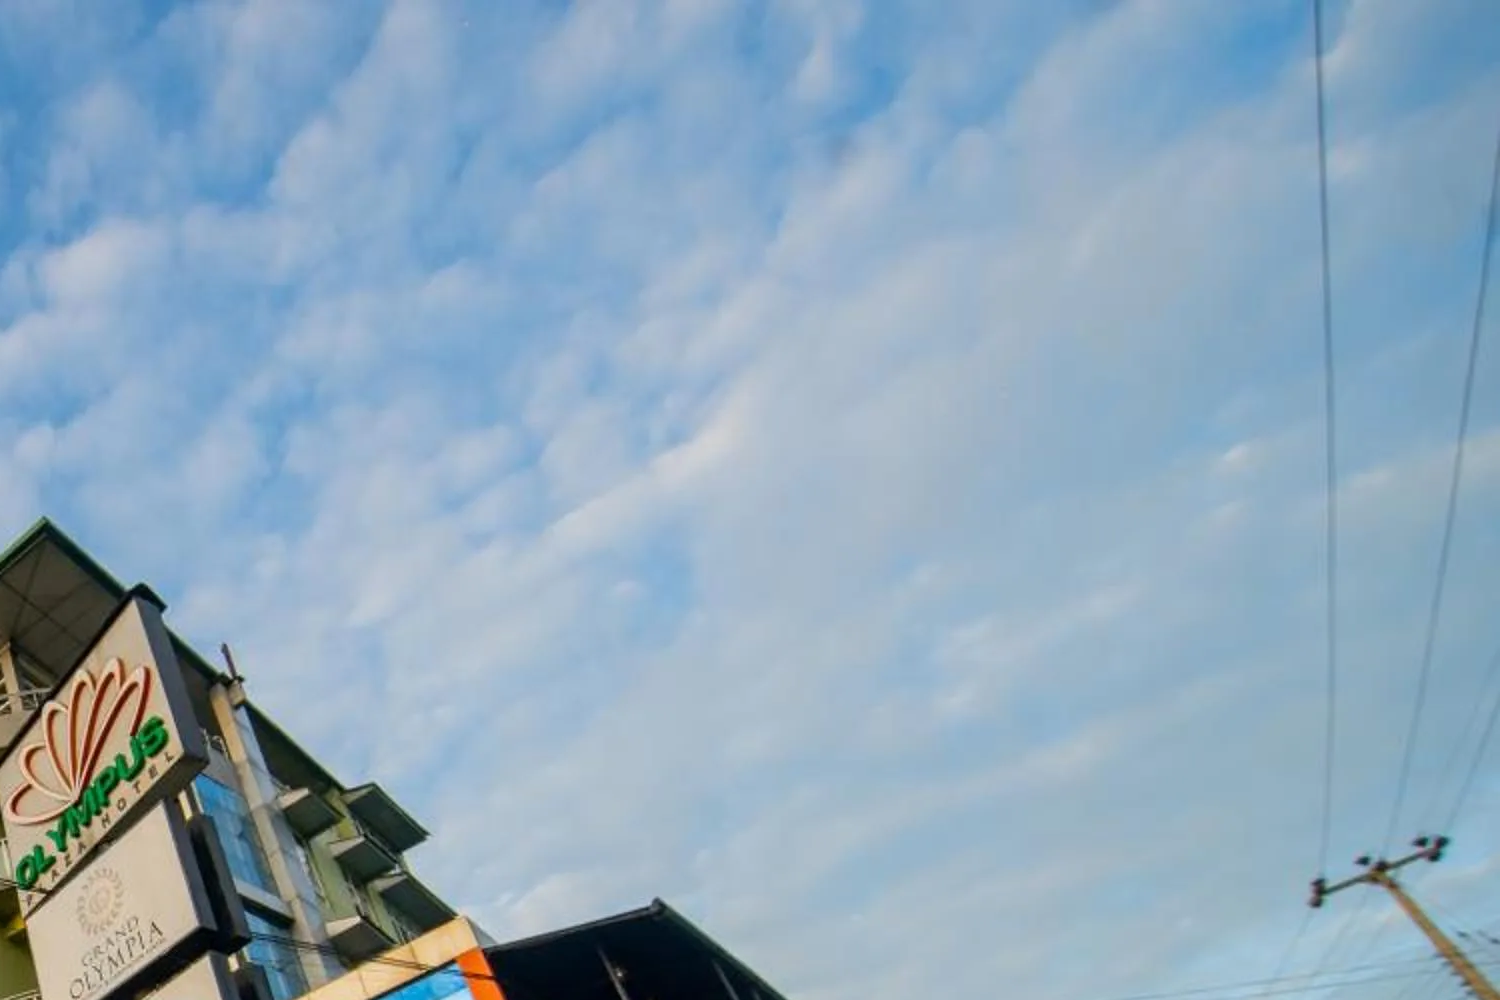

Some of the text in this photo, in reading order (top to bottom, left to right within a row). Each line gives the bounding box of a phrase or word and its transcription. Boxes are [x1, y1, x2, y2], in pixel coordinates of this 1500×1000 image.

[16, 716, 169, 890] OLYMPUS
[101, 752, 174, 828] HOTEL
[69, 920, 164, 1000] OLYMPIA
[82, 916, 139, 967] GRAND
